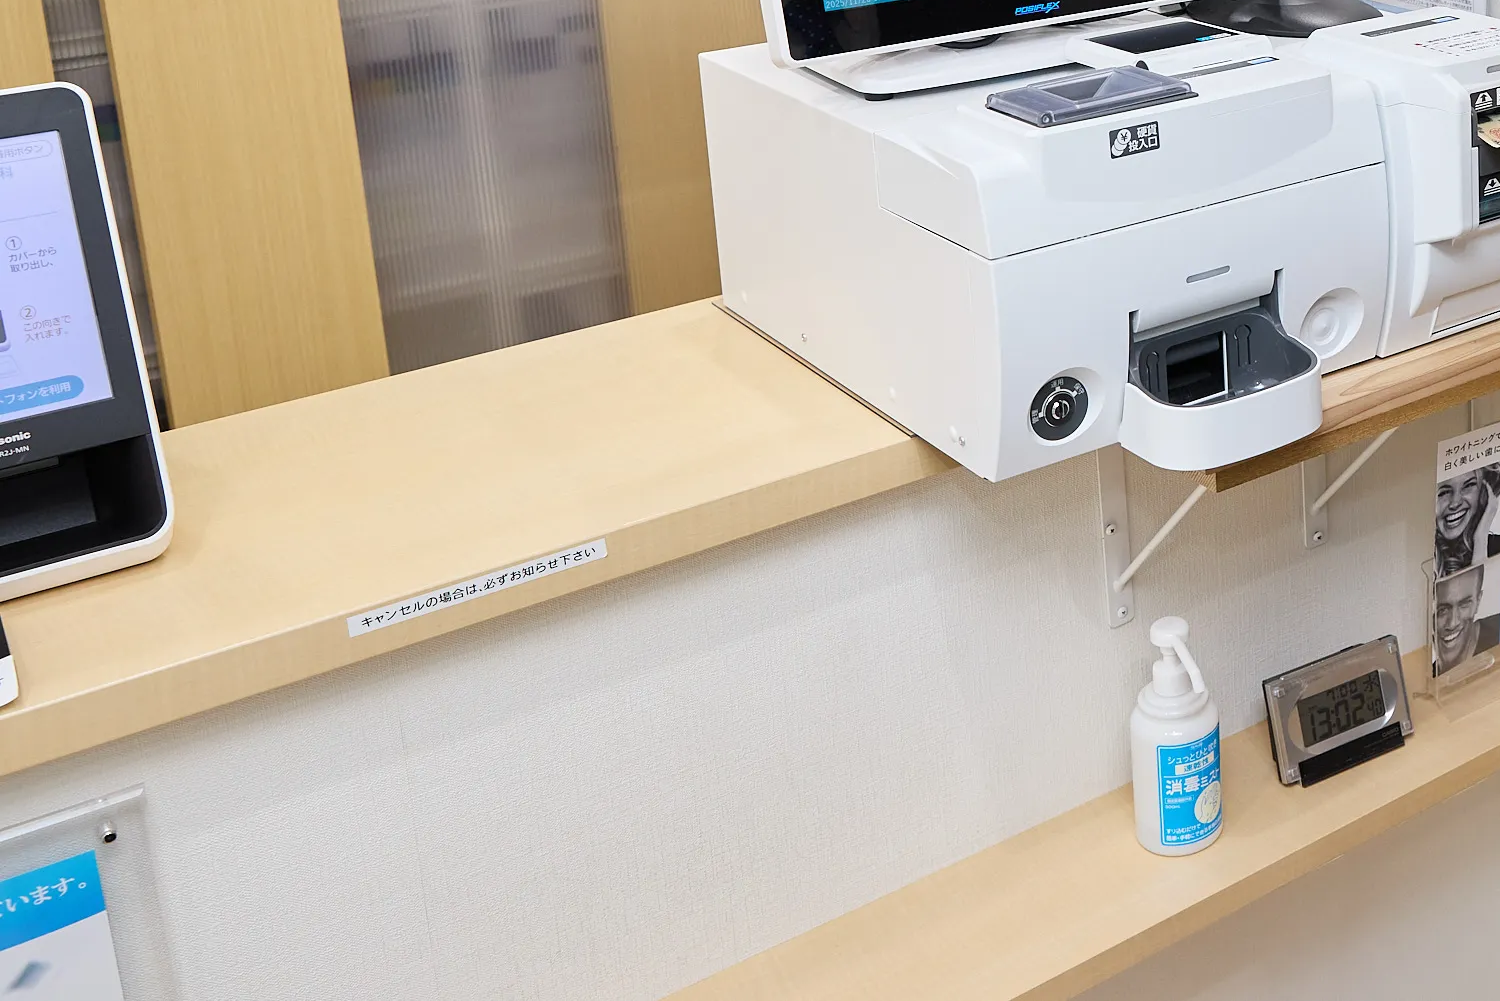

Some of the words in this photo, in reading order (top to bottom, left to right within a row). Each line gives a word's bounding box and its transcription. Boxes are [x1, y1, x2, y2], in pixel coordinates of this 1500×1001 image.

[1015, 1, 1060, 16] POSIFLEX
[1136, 123, 1158, 139] 硬貨
[1128, 135, 1158, 152] 投入口
[8, 247, 57, 263] カバーから
[23, 314, 72, 332] この向きで
[0, 381, 72, 405] フォンを利用
[361, 547, 597, 628] キャンセルの場合は、必ずお知らせ下さい
[1165, 767, 1220, 796] 消毒ミスト
[0, 877, 88, 919] います。
